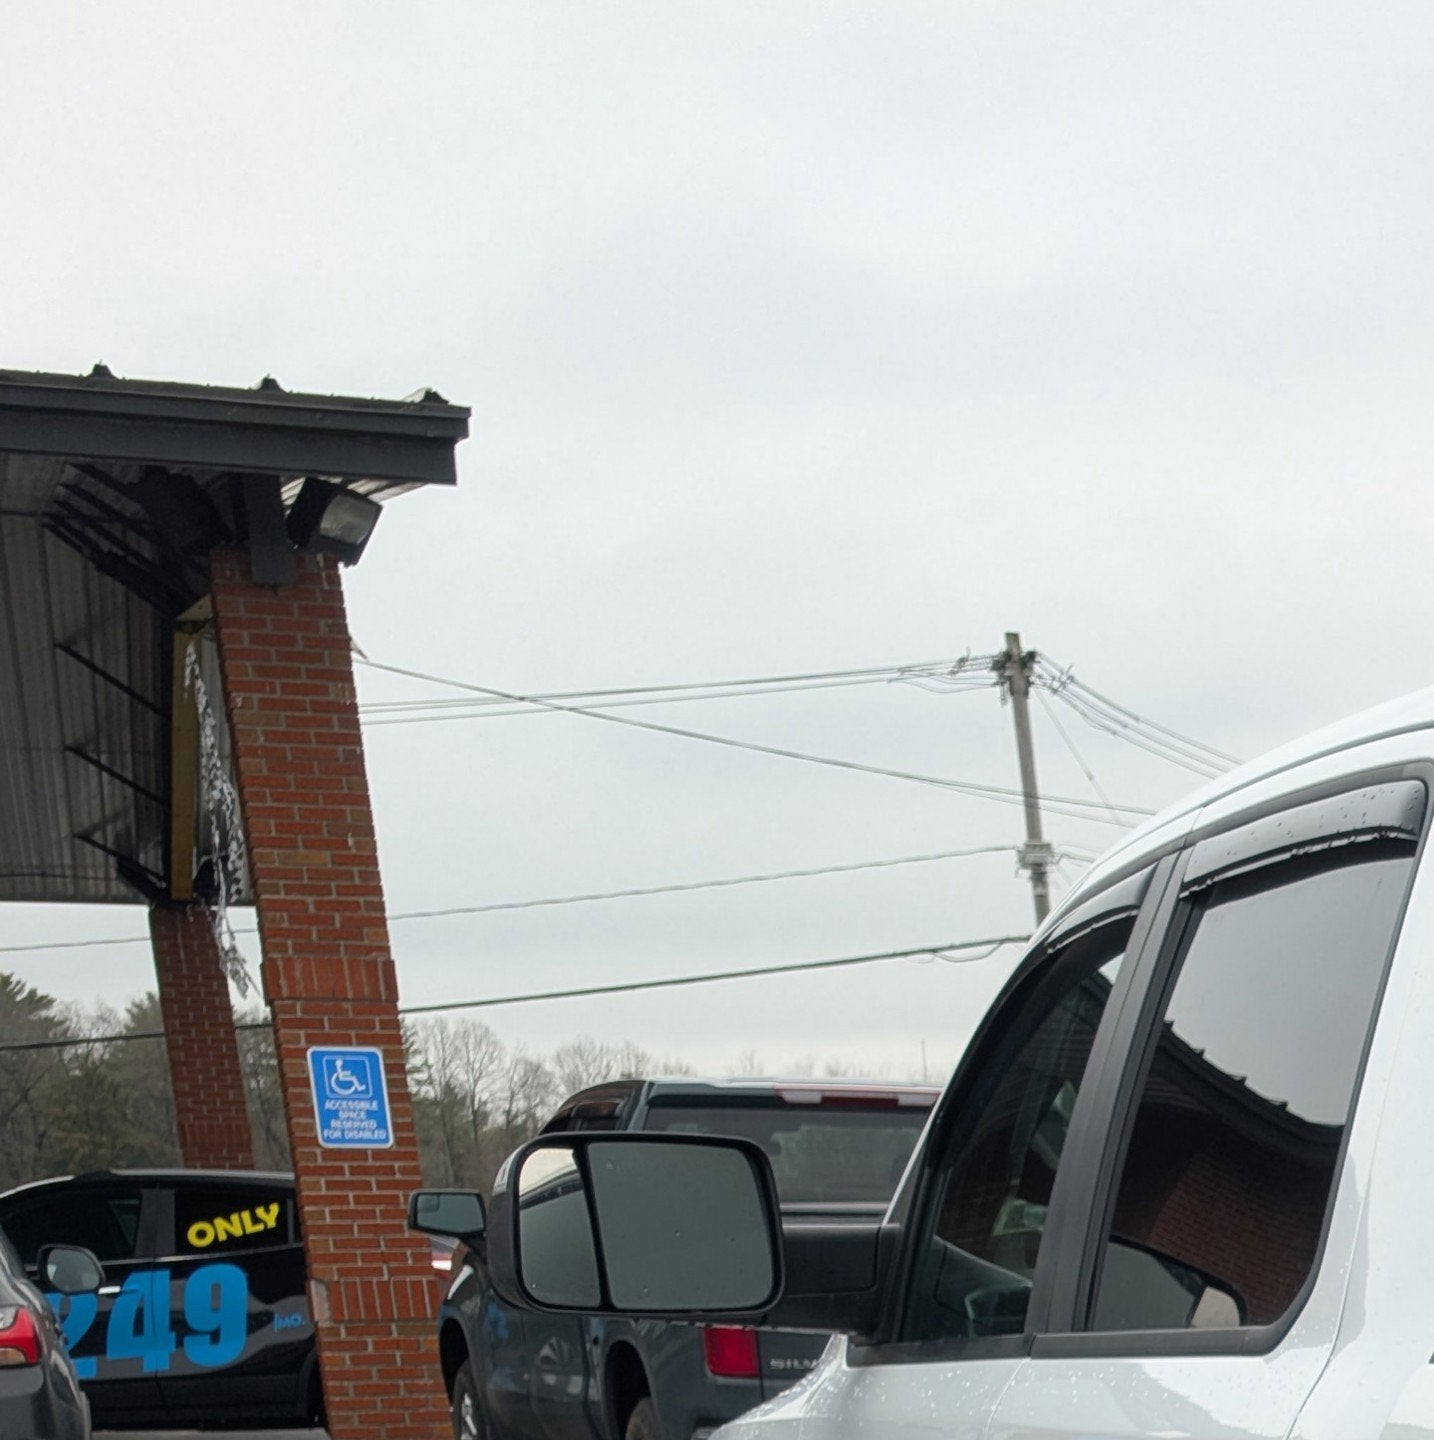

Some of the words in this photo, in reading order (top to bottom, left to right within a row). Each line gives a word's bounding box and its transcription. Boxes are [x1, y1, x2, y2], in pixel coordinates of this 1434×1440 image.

[325, 1100, 378, 1111] ACCESSIBLE
[339, 1111, 366, 1120] SPACE
[331, 1120, 377, 1129] RESERVED
[324, 1129, 342, 1139] FOR
[344, 1129, 386, 1140] DISABLED
[187, 1203, 279, 1248] ONLY
